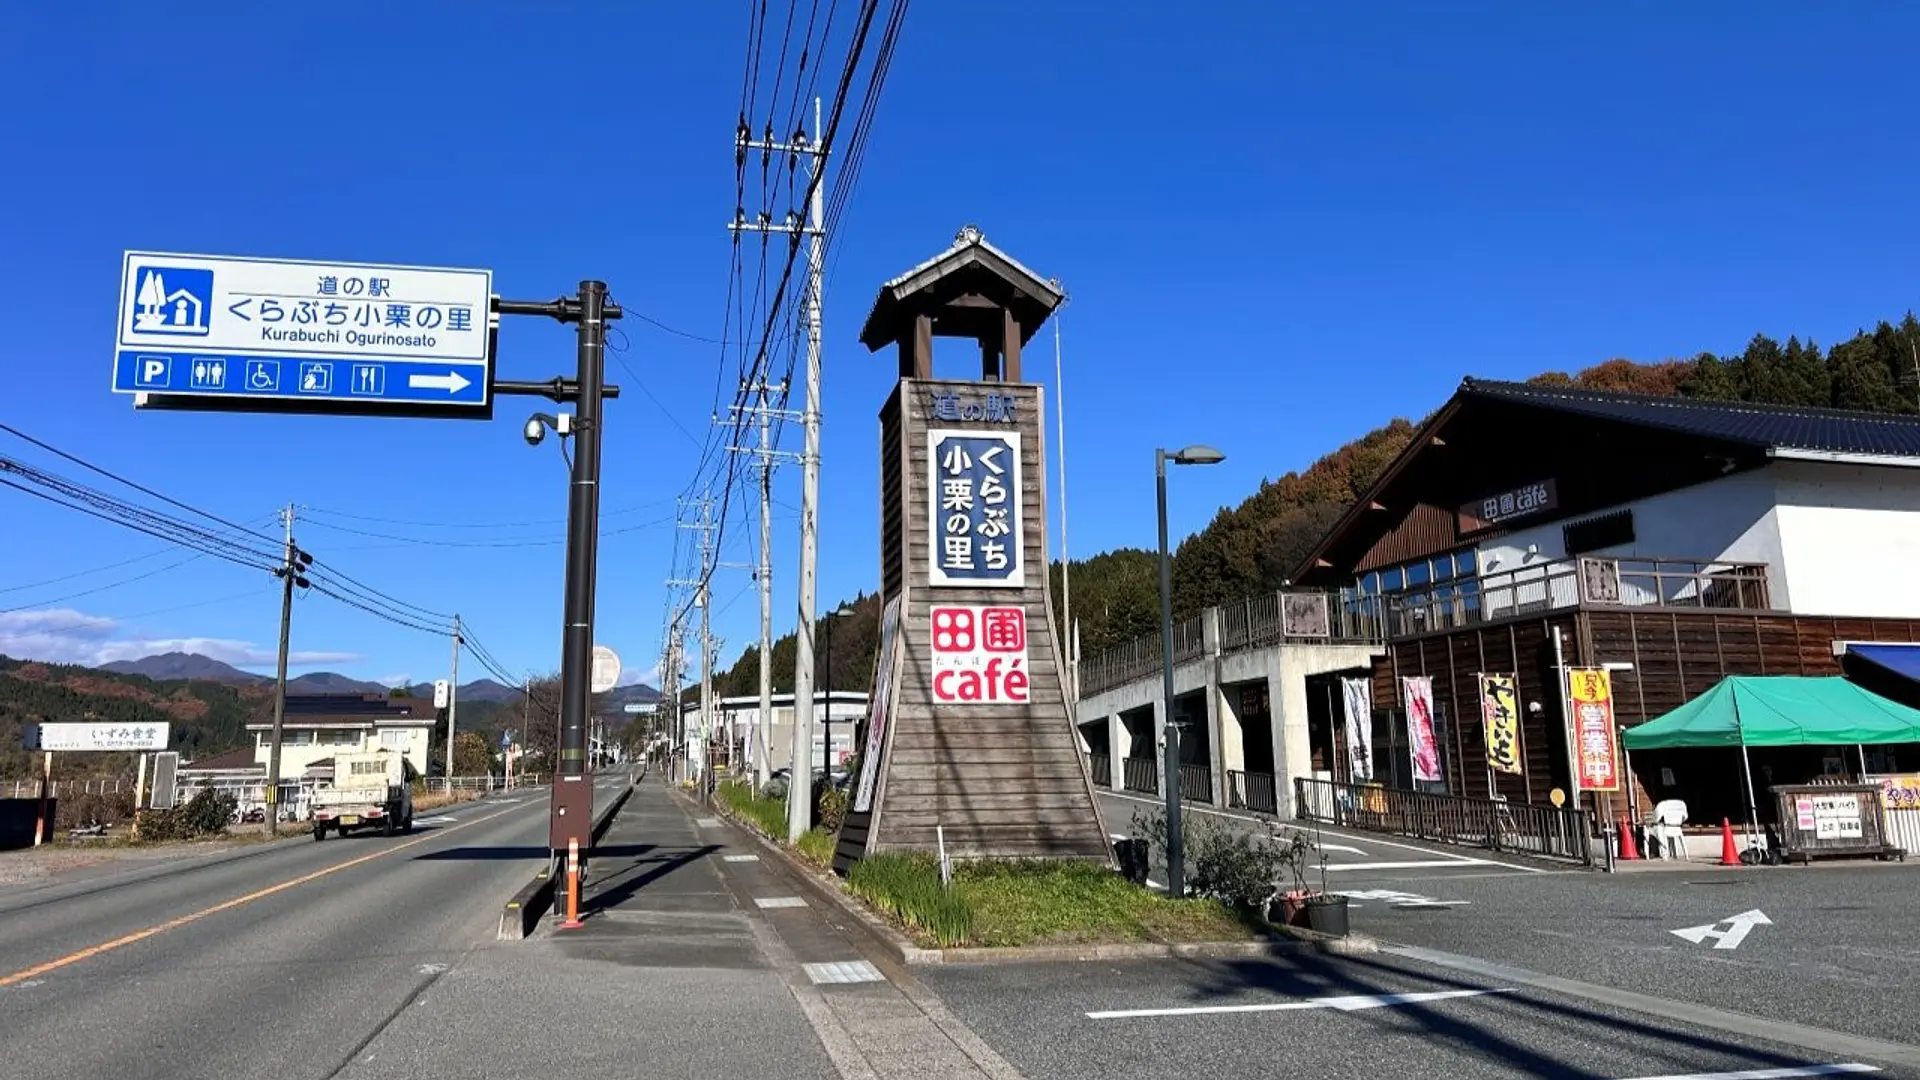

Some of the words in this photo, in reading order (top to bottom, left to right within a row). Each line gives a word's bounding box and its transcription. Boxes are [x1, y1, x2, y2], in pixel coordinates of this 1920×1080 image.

[317, 276, 391, 298] 道の駅
[228, 298, 473, 332] くらぶち小栗の里
[261, 326, 340, 344] Kurabuchi
[346, 330, 437, 348] Ogurinosato
[144, 360, 165, 383] P
[930, 390, 1017, 423] 道の駅
[942, 444, 975, 570] 小栗の里
[976, 446, 1010, 570] くらぶち
[934, 657, 1028, 701] café
[91, 726, 157, 740] いずみ食堂
[1581, 703, 1611, 785] 営業中
